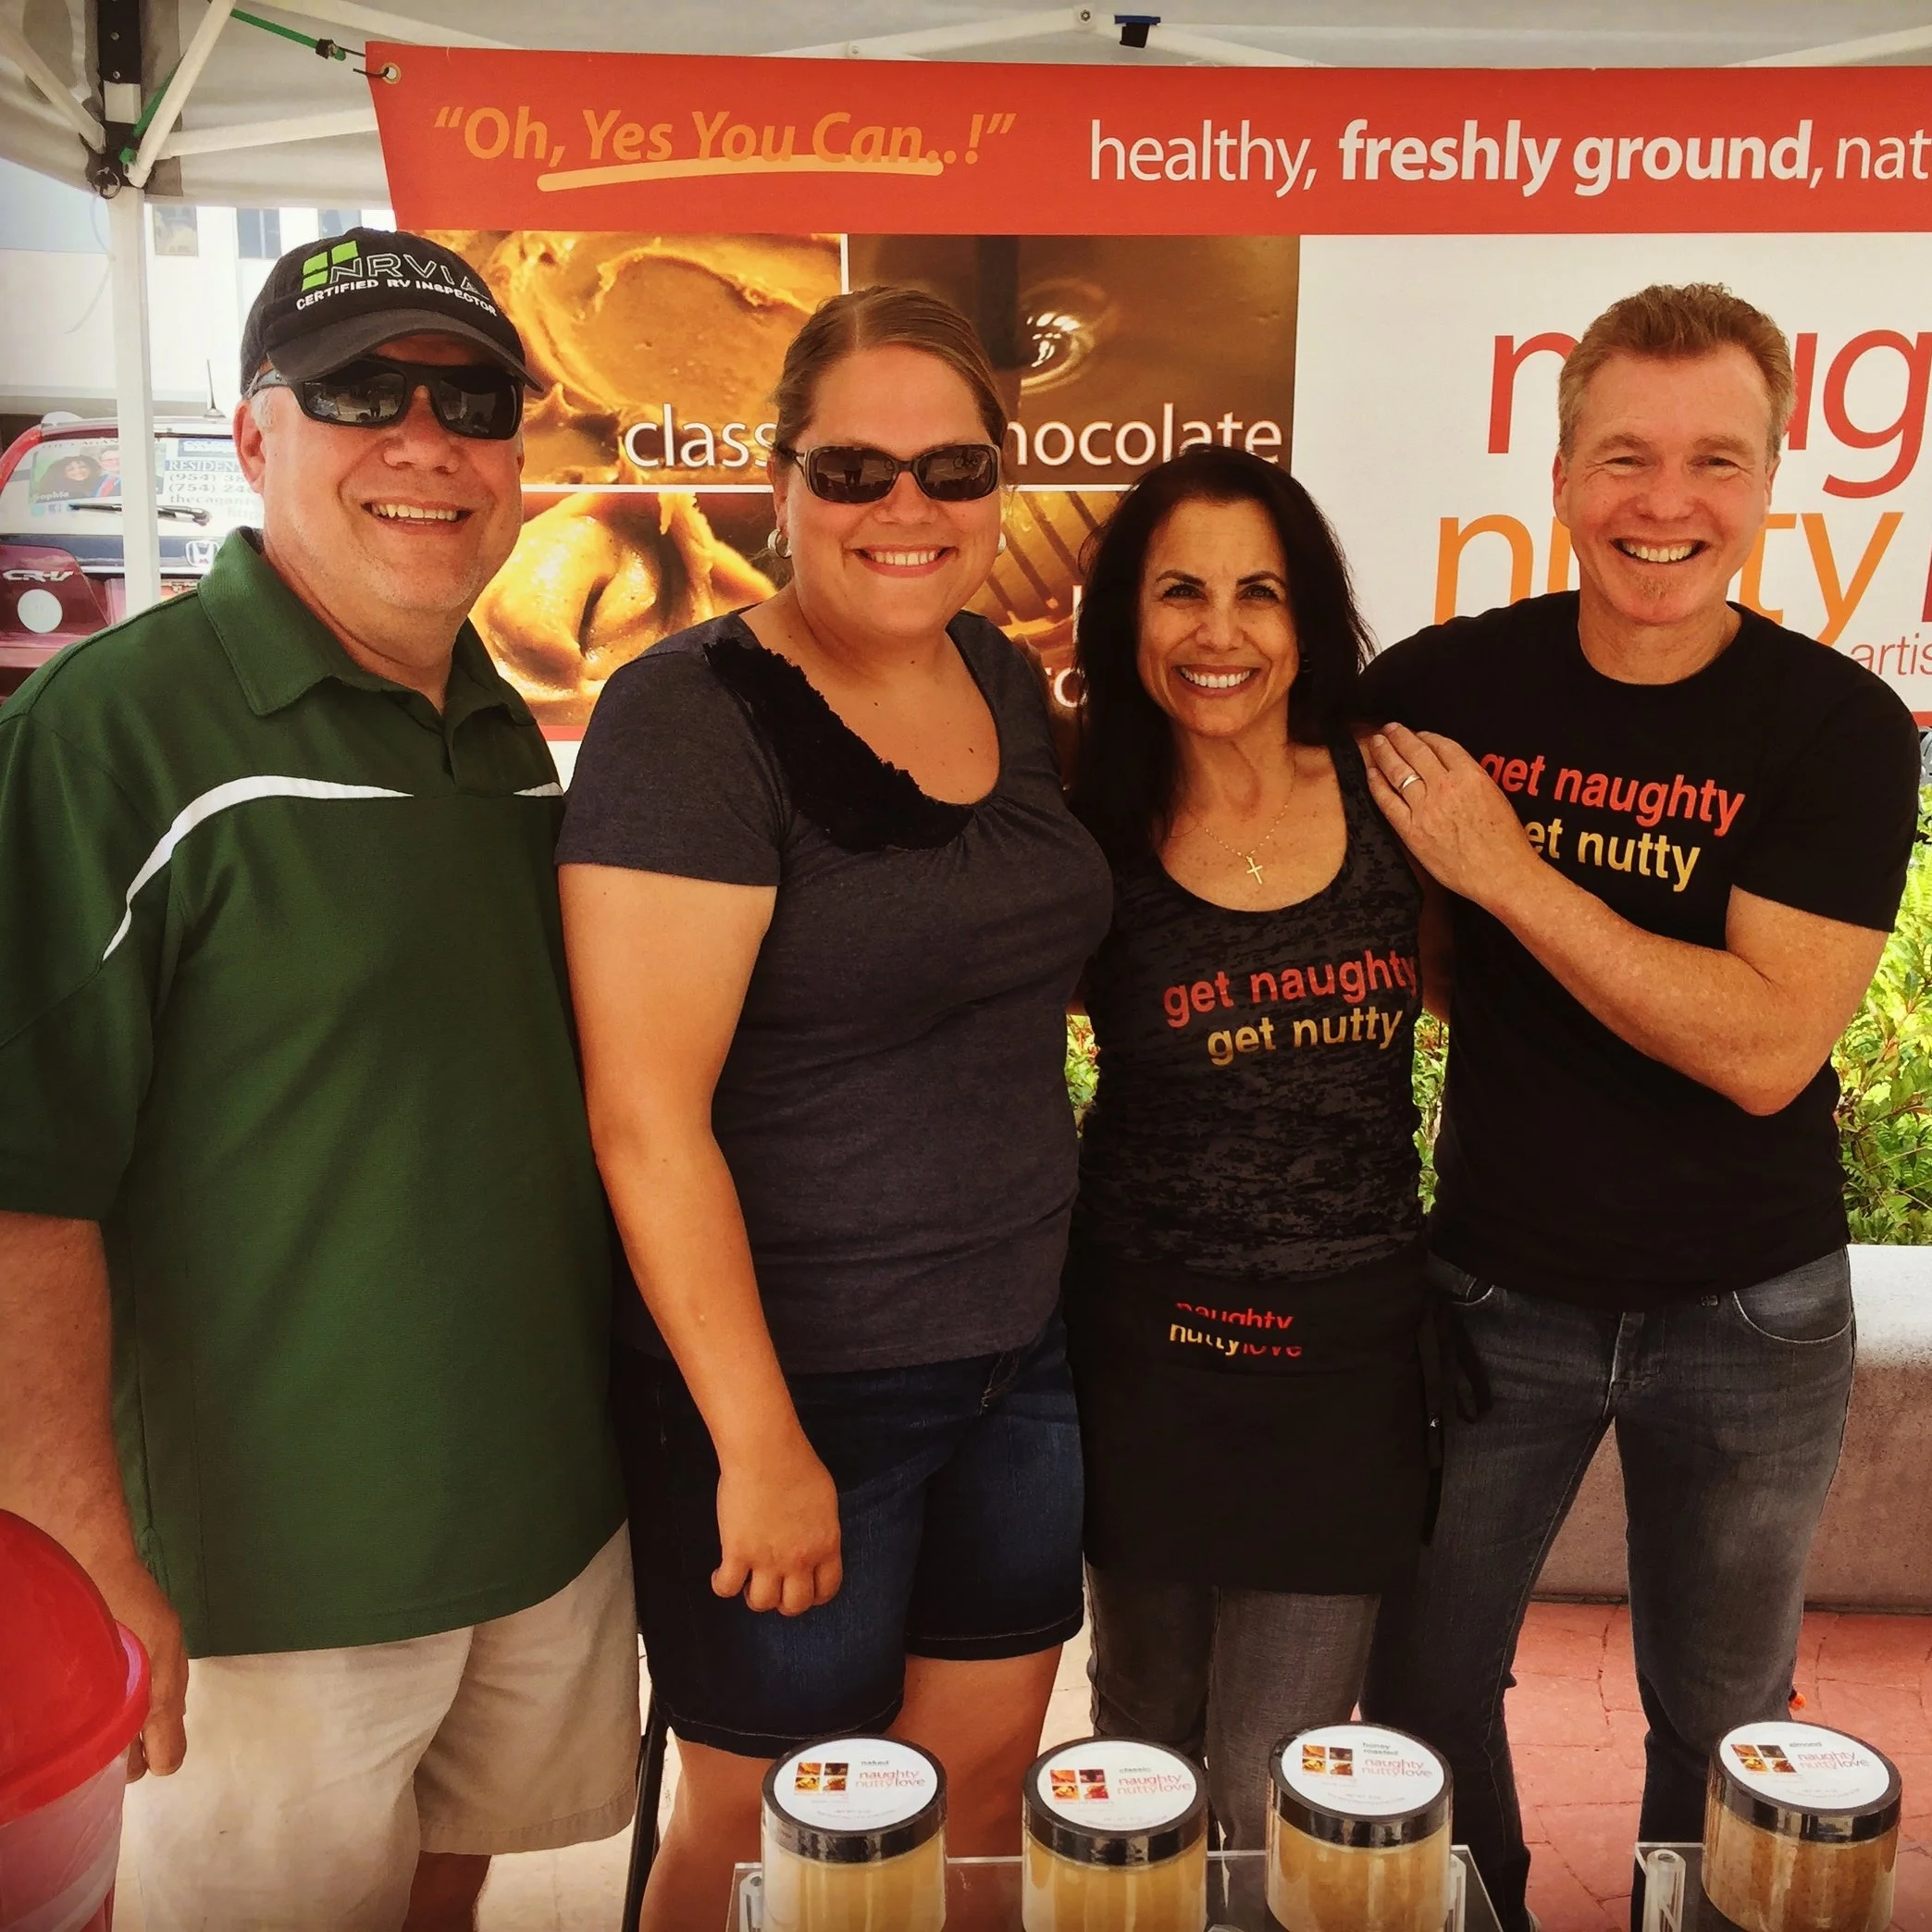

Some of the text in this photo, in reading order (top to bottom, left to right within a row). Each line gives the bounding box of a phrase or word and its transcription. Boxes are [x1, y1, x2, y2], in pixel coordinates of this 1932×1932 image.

[582, 109, 674, 161] Yes
[691, 110, 796, 162] You
[1090, 118, 1932, 198] healthy, freshly ground, nat
[296, 279, 498, 316] CERTIFIED RV INSPECTOR
[329, 253, 489, 301] NRVIA
[625, 402, 778, 467] class
[1007, 402, 1282, 466] ocolate
[168, 461, 242, 473] RESIDEN
[224, 474, 246, 482] 38
[3, 569, 74, 583] CR-V
[1554, 767, 1745, 837] naughty
[1524, 818, 1701, 893] et nutty
[1163, 949, 1418, 1028] get naughty
[1208, 1006, 1404, 1066] get nutty
[1362, 1741, 1391, 1751] honey
[1364, 1758, 1425, 1772] naughty
[1797, 1751, 1858, 1765] naughty
[859, 1768, 920, 1783] naughty
[1118, 1773, 1183, 1787] naughty
